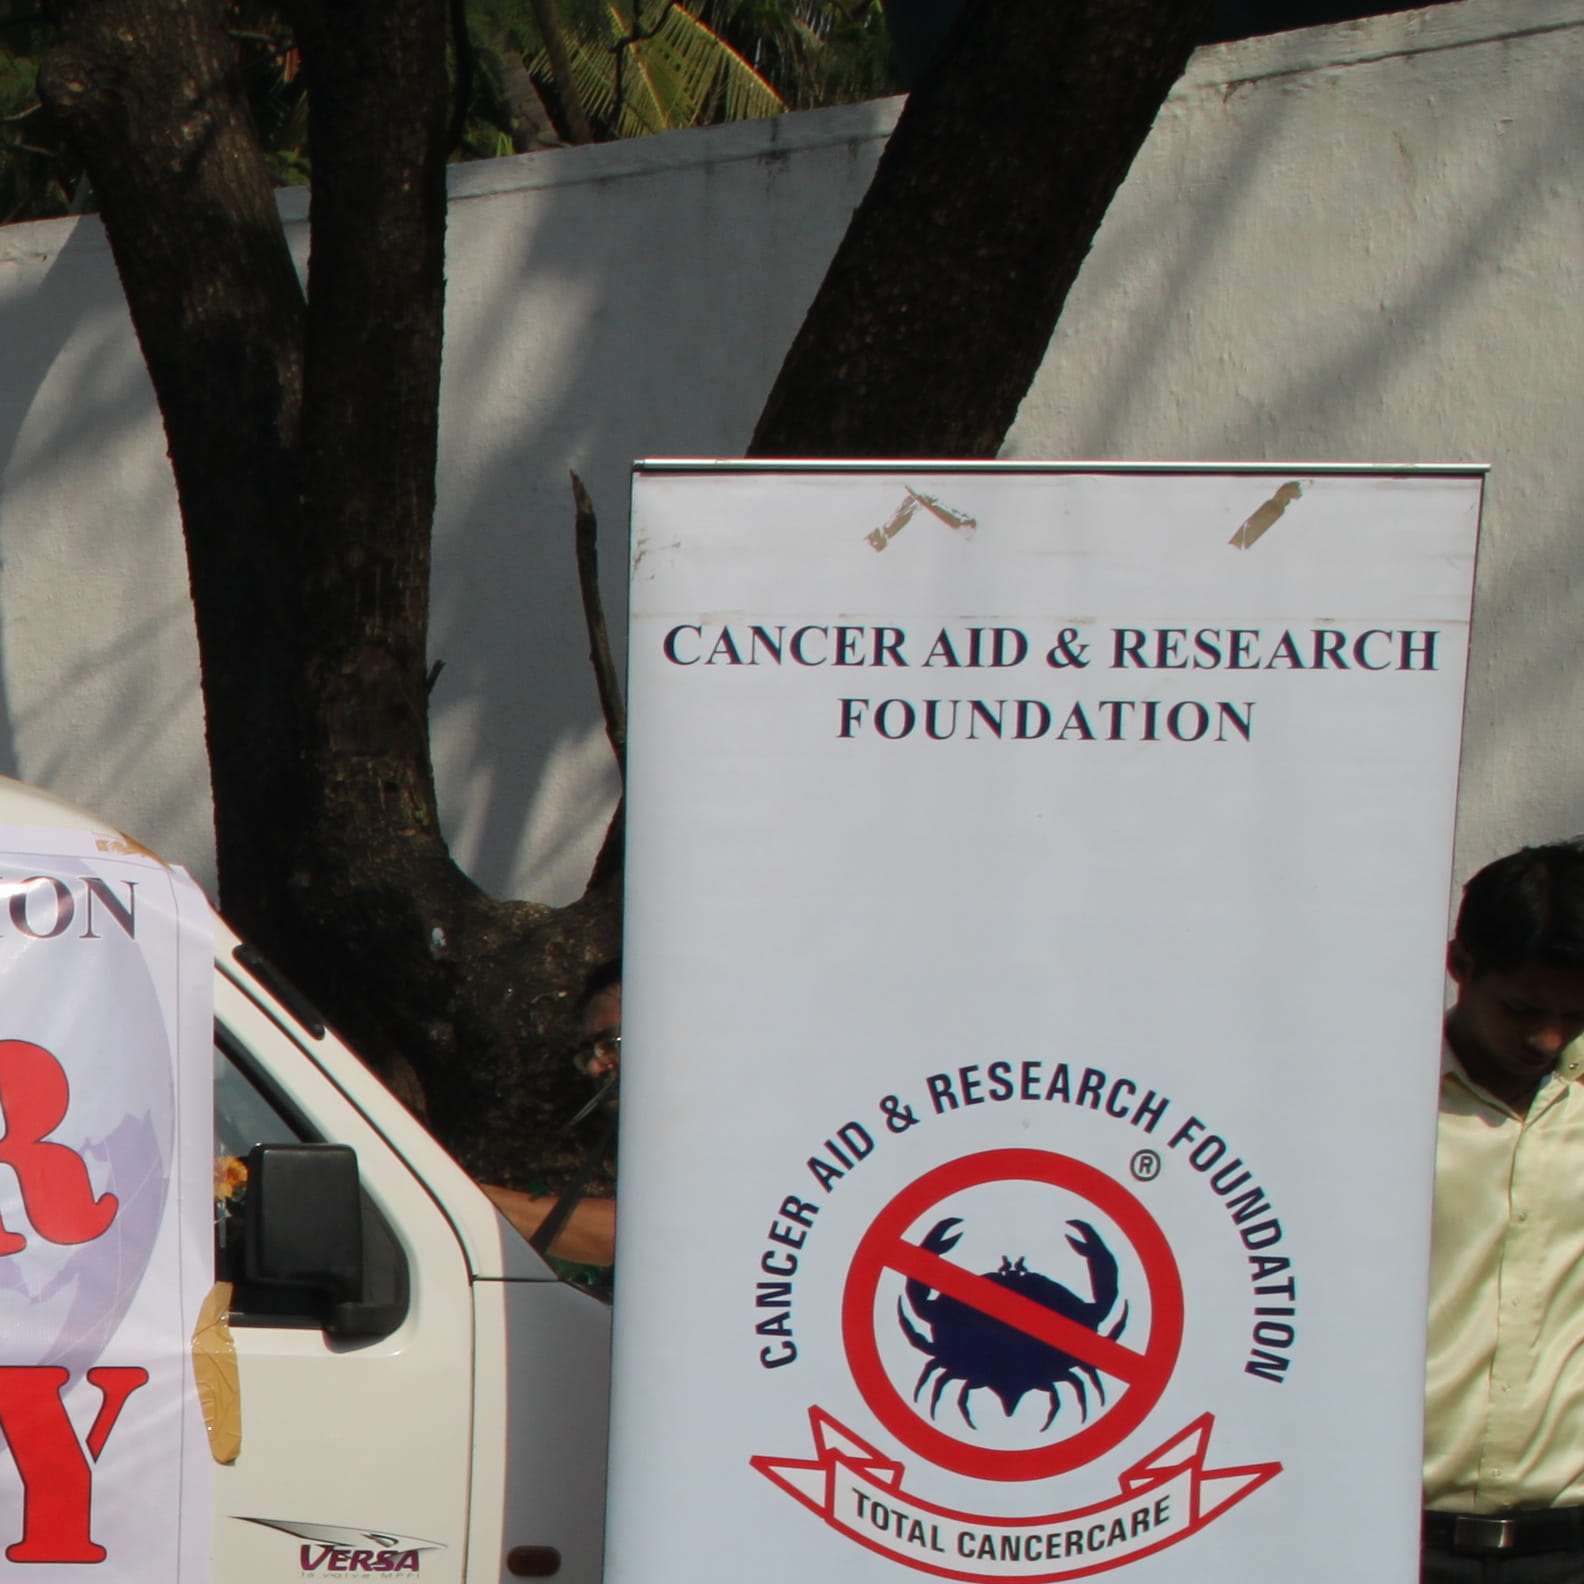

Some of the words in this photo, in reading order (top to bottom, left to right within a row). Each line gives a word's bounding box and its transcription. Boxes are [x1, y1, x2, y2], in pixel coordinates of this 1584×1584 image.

[663, 625, 909, 669] CANCER
[923, 628, 1029, 669] AID
[1046, 628, 1090, 670] &
[1112, 629, 1438, 672] RESEARCH
[839, 699, 1254, 743] FOUNDATION
[754, 1193, 820, 1371] CANCER
[805, 1119, 877, 1194] AID
[878, 1094, 921, 1135] &
[926, 1060, 1171, 1136] RESEARCH
[1166, 1114, 1297, 1385] FOUNDATION
[851, 1485, 947, 1555] TOTAL
[957, 1493, 1173, 1563] CANCERCARE
[300, 1544, 420, 1572] VERSA
